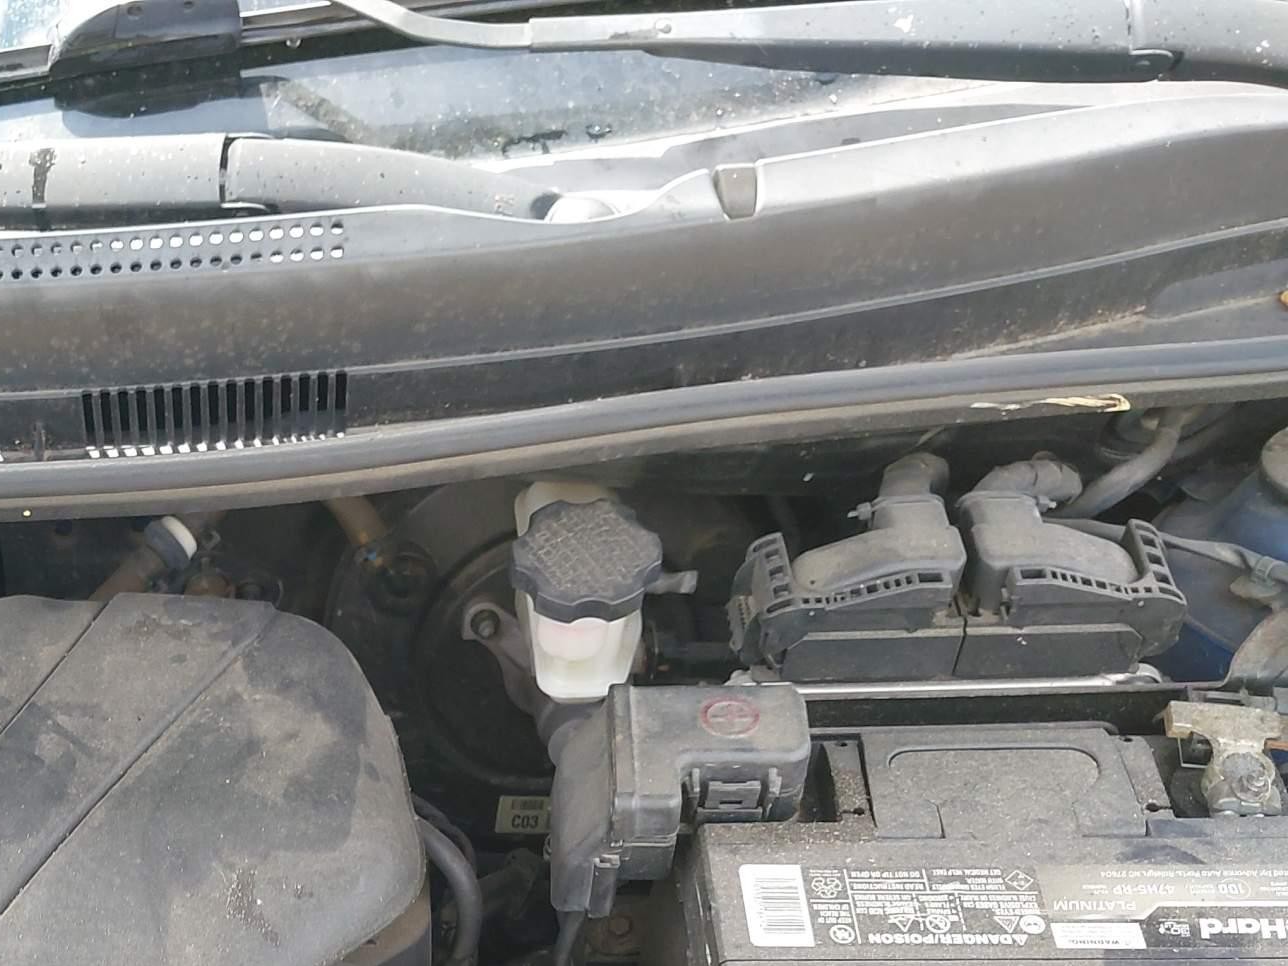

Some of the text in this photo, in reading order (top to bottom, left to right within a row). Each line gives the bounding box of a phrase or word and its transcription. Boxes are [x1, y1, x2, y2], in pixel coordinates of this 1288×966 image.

[511, 815, 539, 828] C03
[1053, 900, 1136, 910] PLATINUM
[1198, 918, 1288, 940] Hard
[868, 932, 1013, 945] DANGER/POISON
